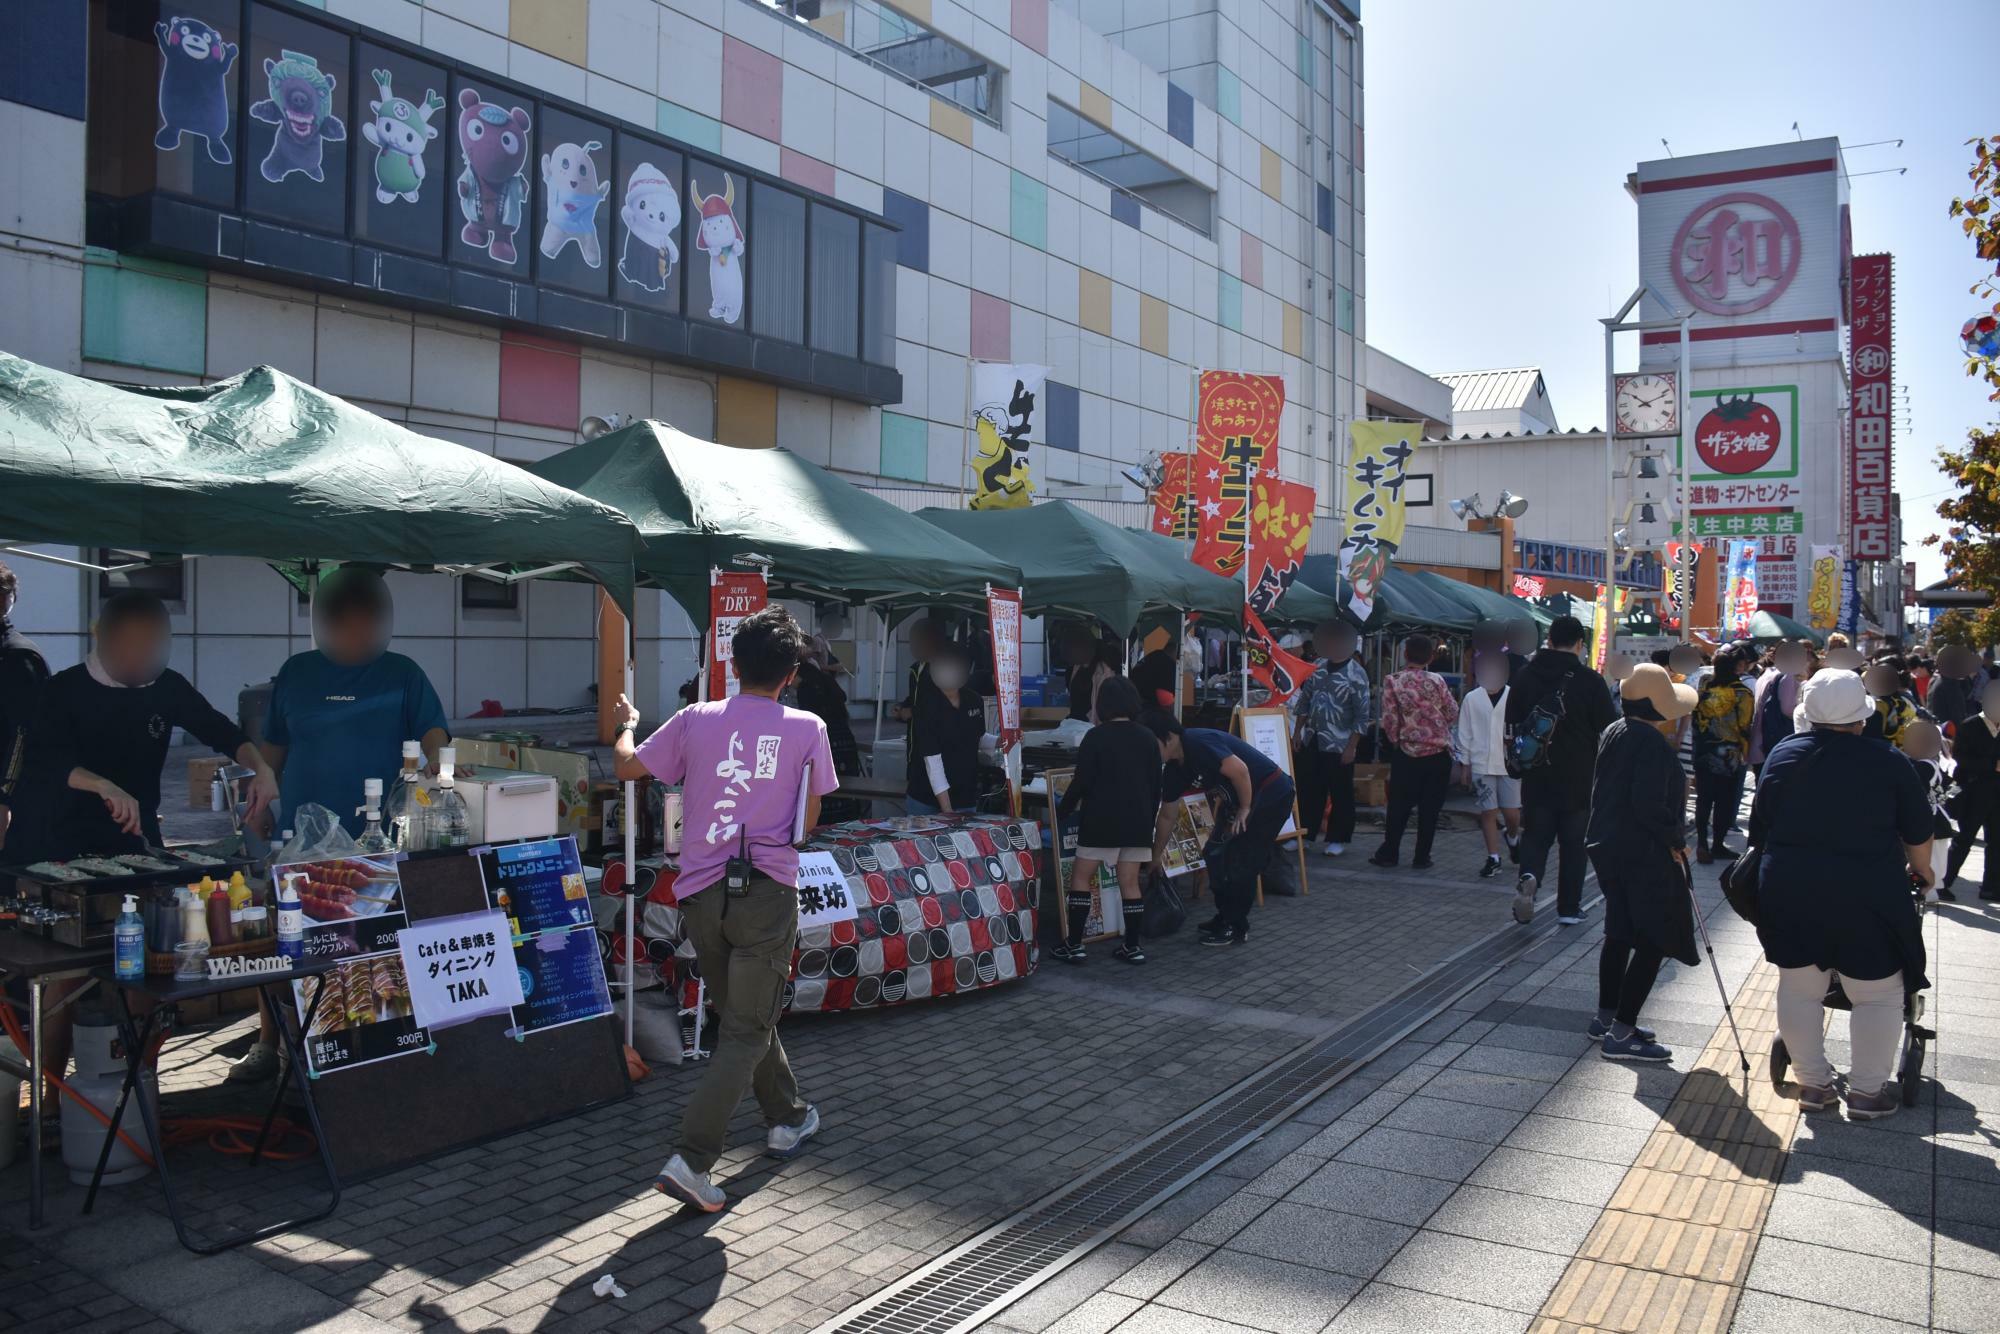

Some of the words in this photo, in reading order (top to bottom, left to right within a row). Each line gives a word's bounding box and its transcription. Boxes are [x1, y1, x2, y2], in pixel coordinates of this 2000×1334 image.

[1854, 275, 1870, 330] プラザ
[1872, 264, 1885, 336] ファッション
[1211, 397, 1257, 411] 焼きたて
[1211, 414, 1257, 428] あつあつ
[1381, 440, 1414, 503] オイ
[1853, 382, 1888, 557] 和田百貨店
[1347, 455, 1386, 554] キムチ
[730, 586, 748, 594] SUPER
[758, 738, 780, 776] 羽生
[705, 730, 752, 845] よさこい
[302, 942, 350, 955] ランクフルト
[206, 954, 293, 979] Welcome
[428, 950, 496, 979] ダイニング
[446, 978, 490, 1004] TAKA
[396, 1032, 424, 1046] 300円
[317, 1050, 350, 1064] はしまき
